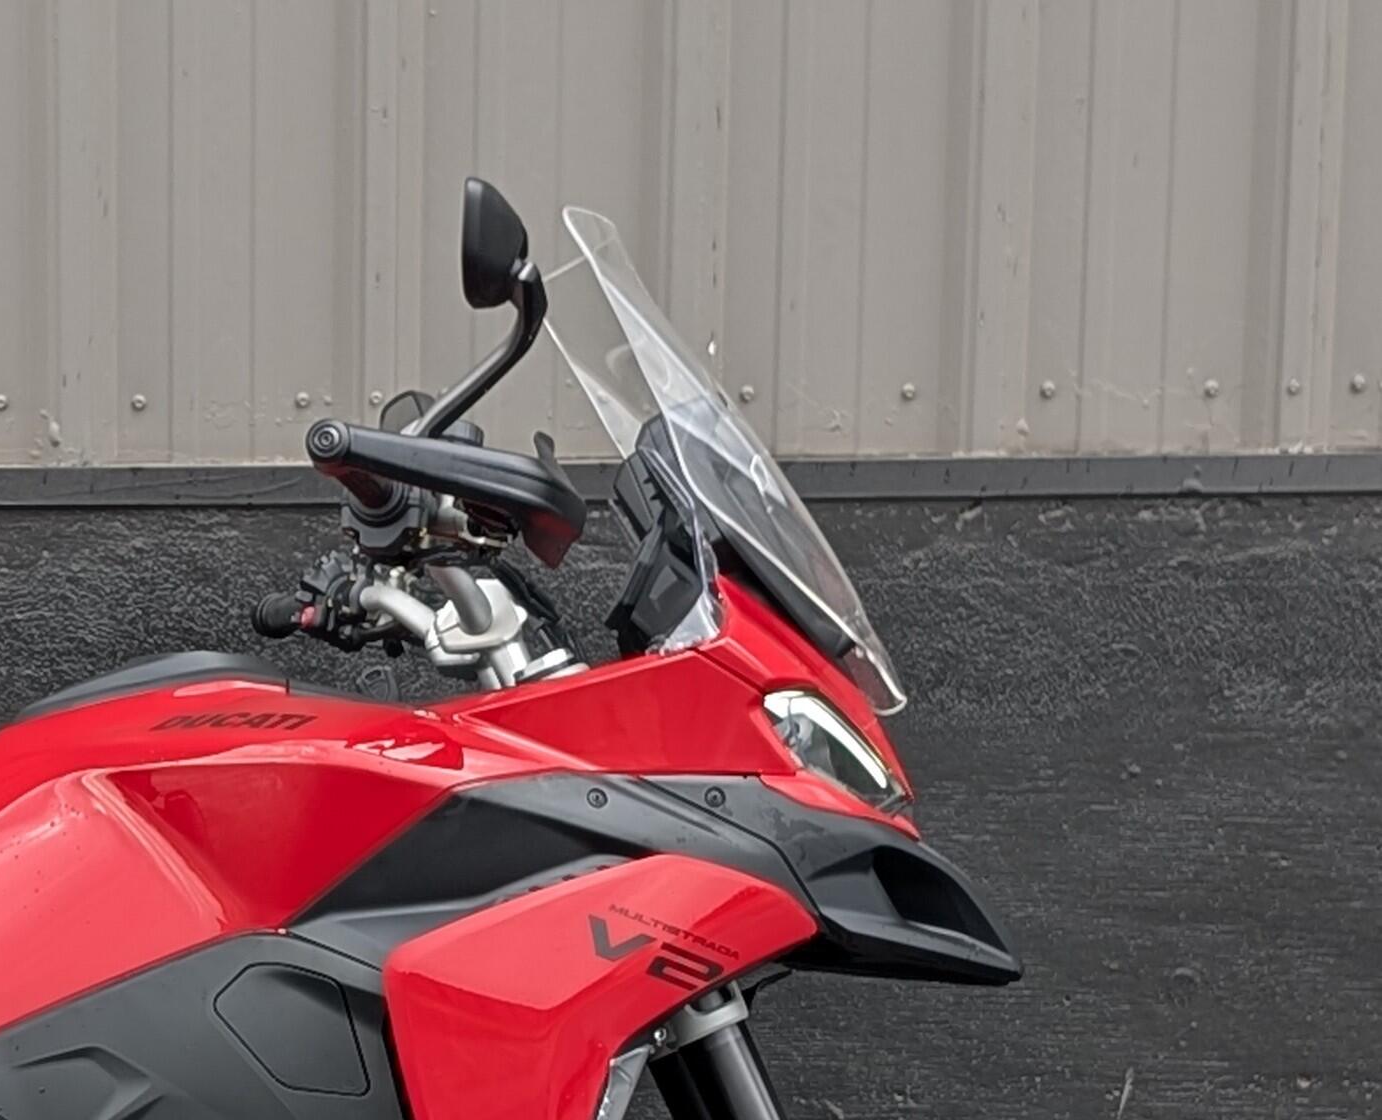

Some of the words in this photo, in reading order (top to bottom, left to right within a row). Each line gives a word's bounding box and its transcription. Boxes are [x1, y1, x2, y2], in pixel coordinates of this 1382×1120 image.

[149, 712, 318, 731] DUCATI
[588, 914, 724, 992] V2
[608, 904, 740, 960] MULTISTRADA
